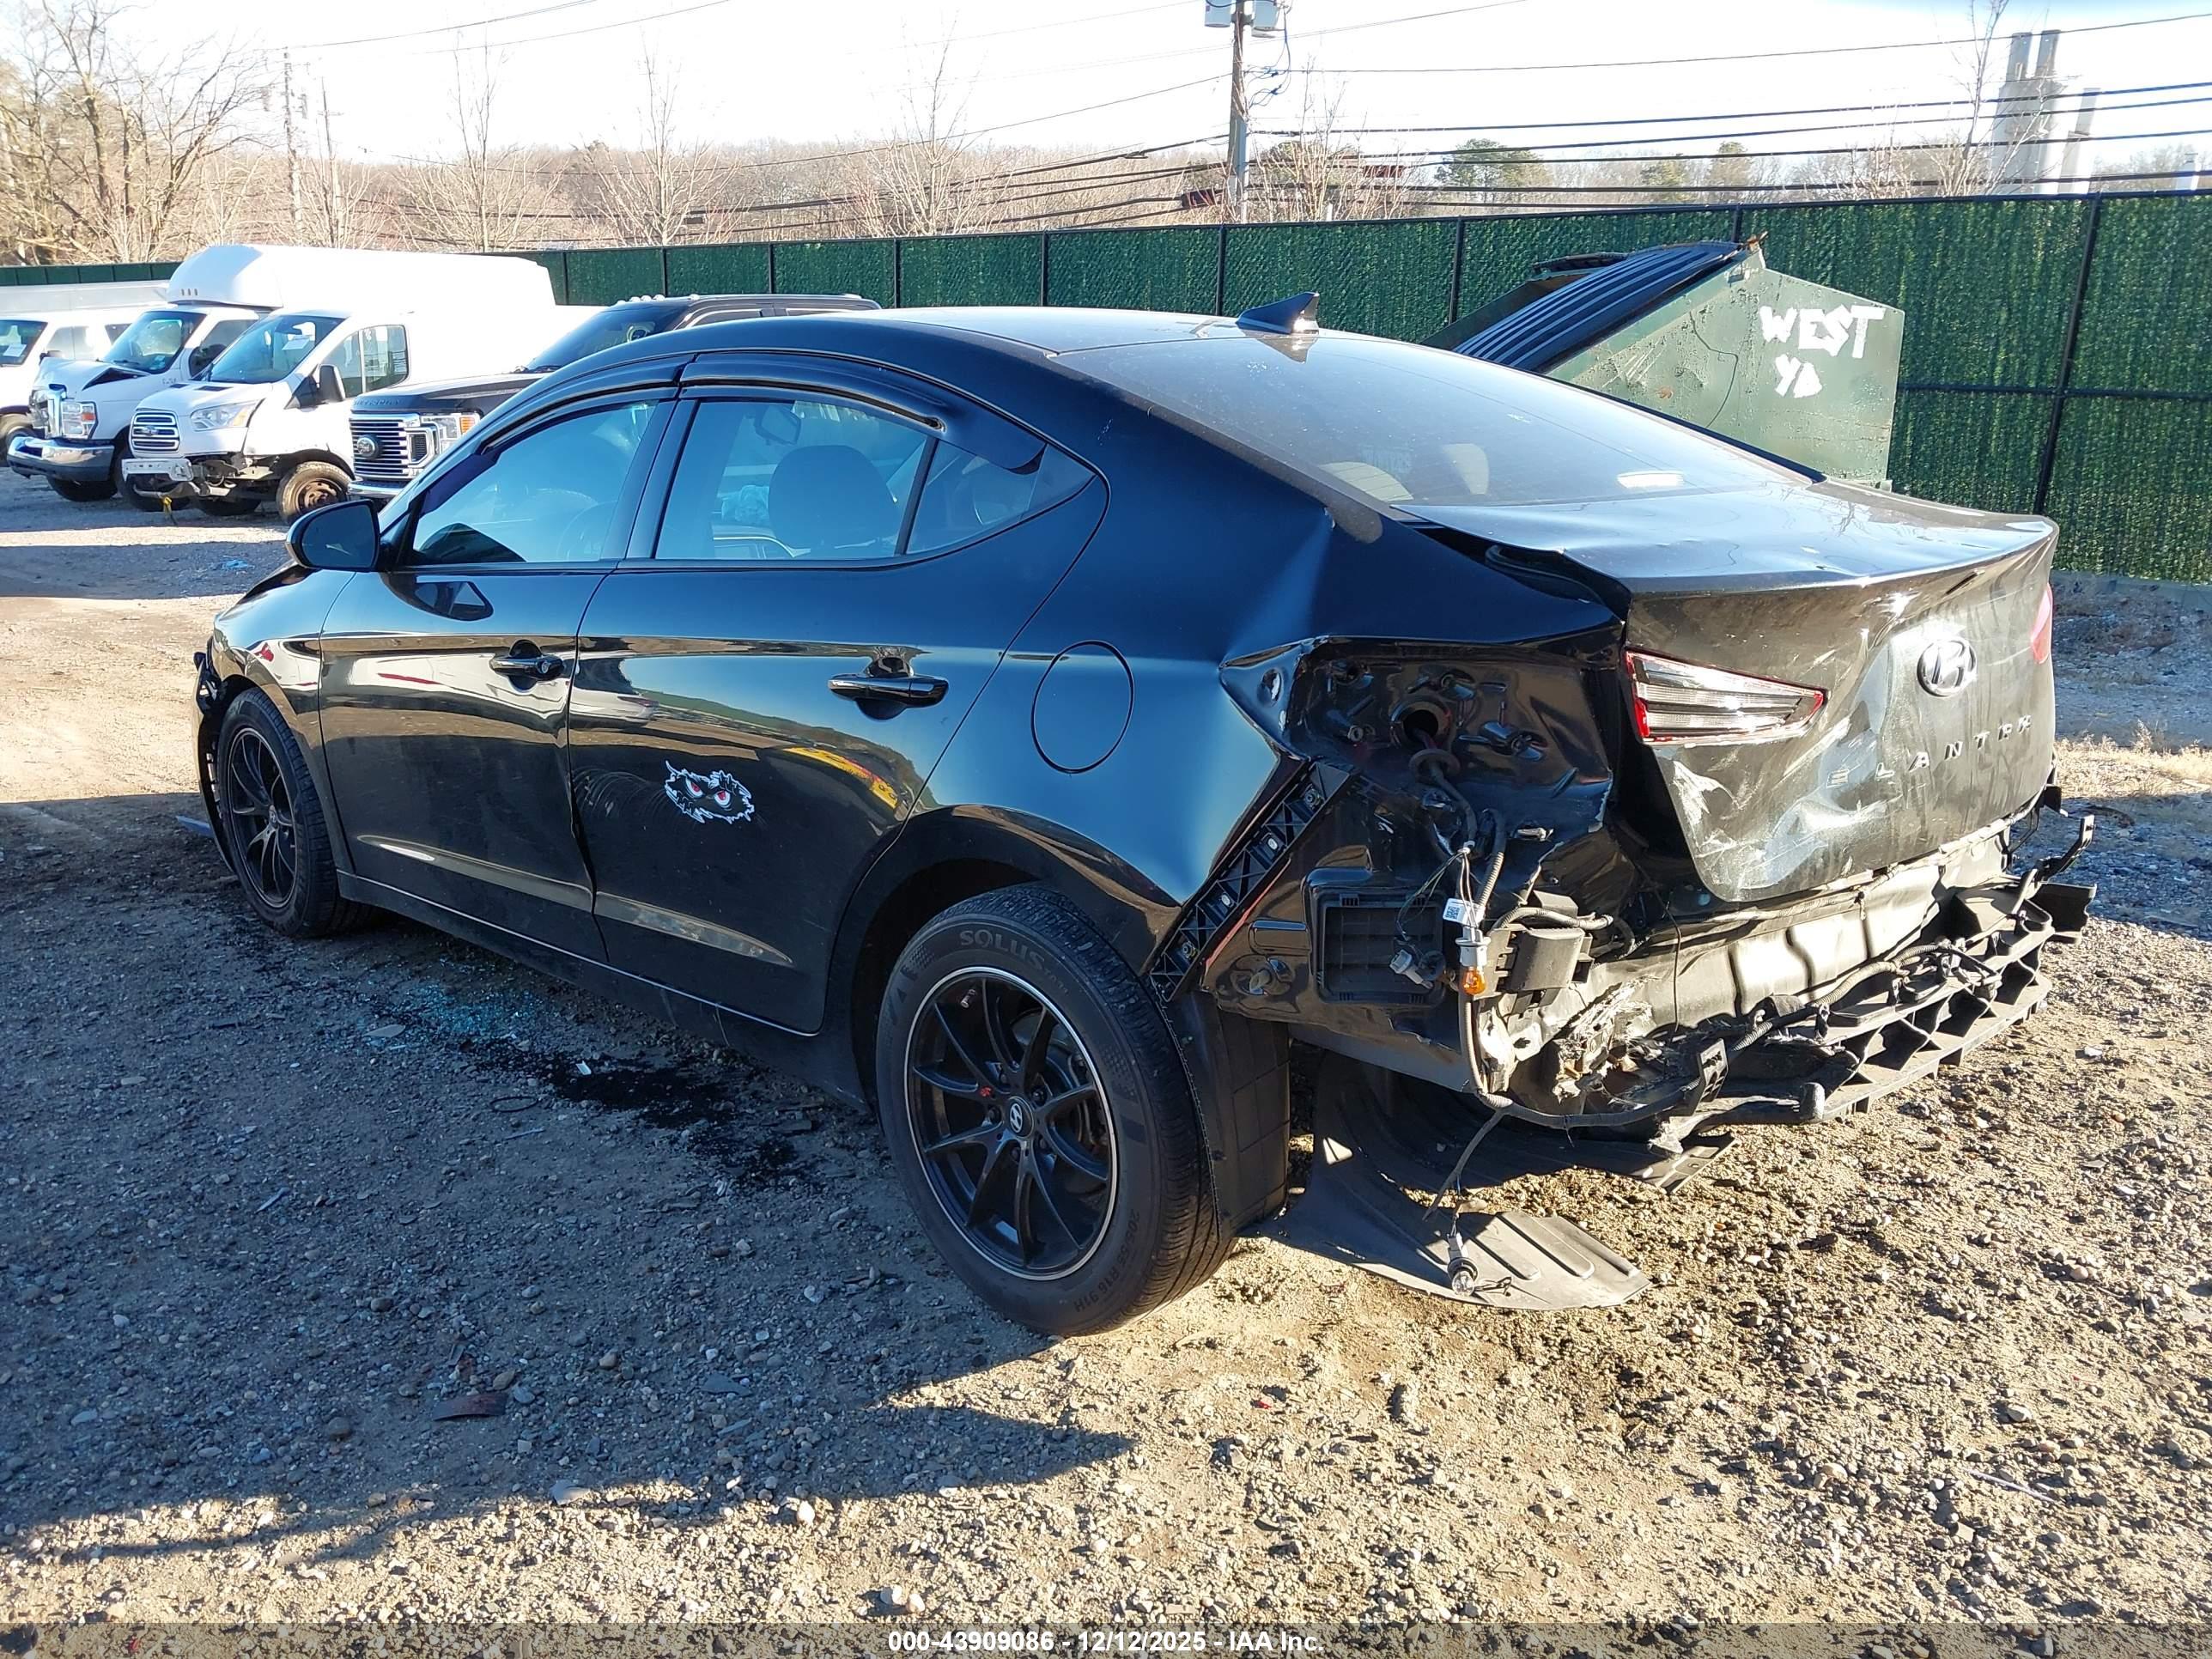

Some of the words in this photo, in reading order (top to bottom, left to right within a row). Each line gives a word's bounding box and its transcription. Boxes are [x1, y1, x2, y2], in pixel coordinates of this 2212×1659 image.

[1760, 304, 1887, 359] WEST
[1826, 714, 2033, 788] ELANTRA
[959, 929, 1045, 970] SOLUS
